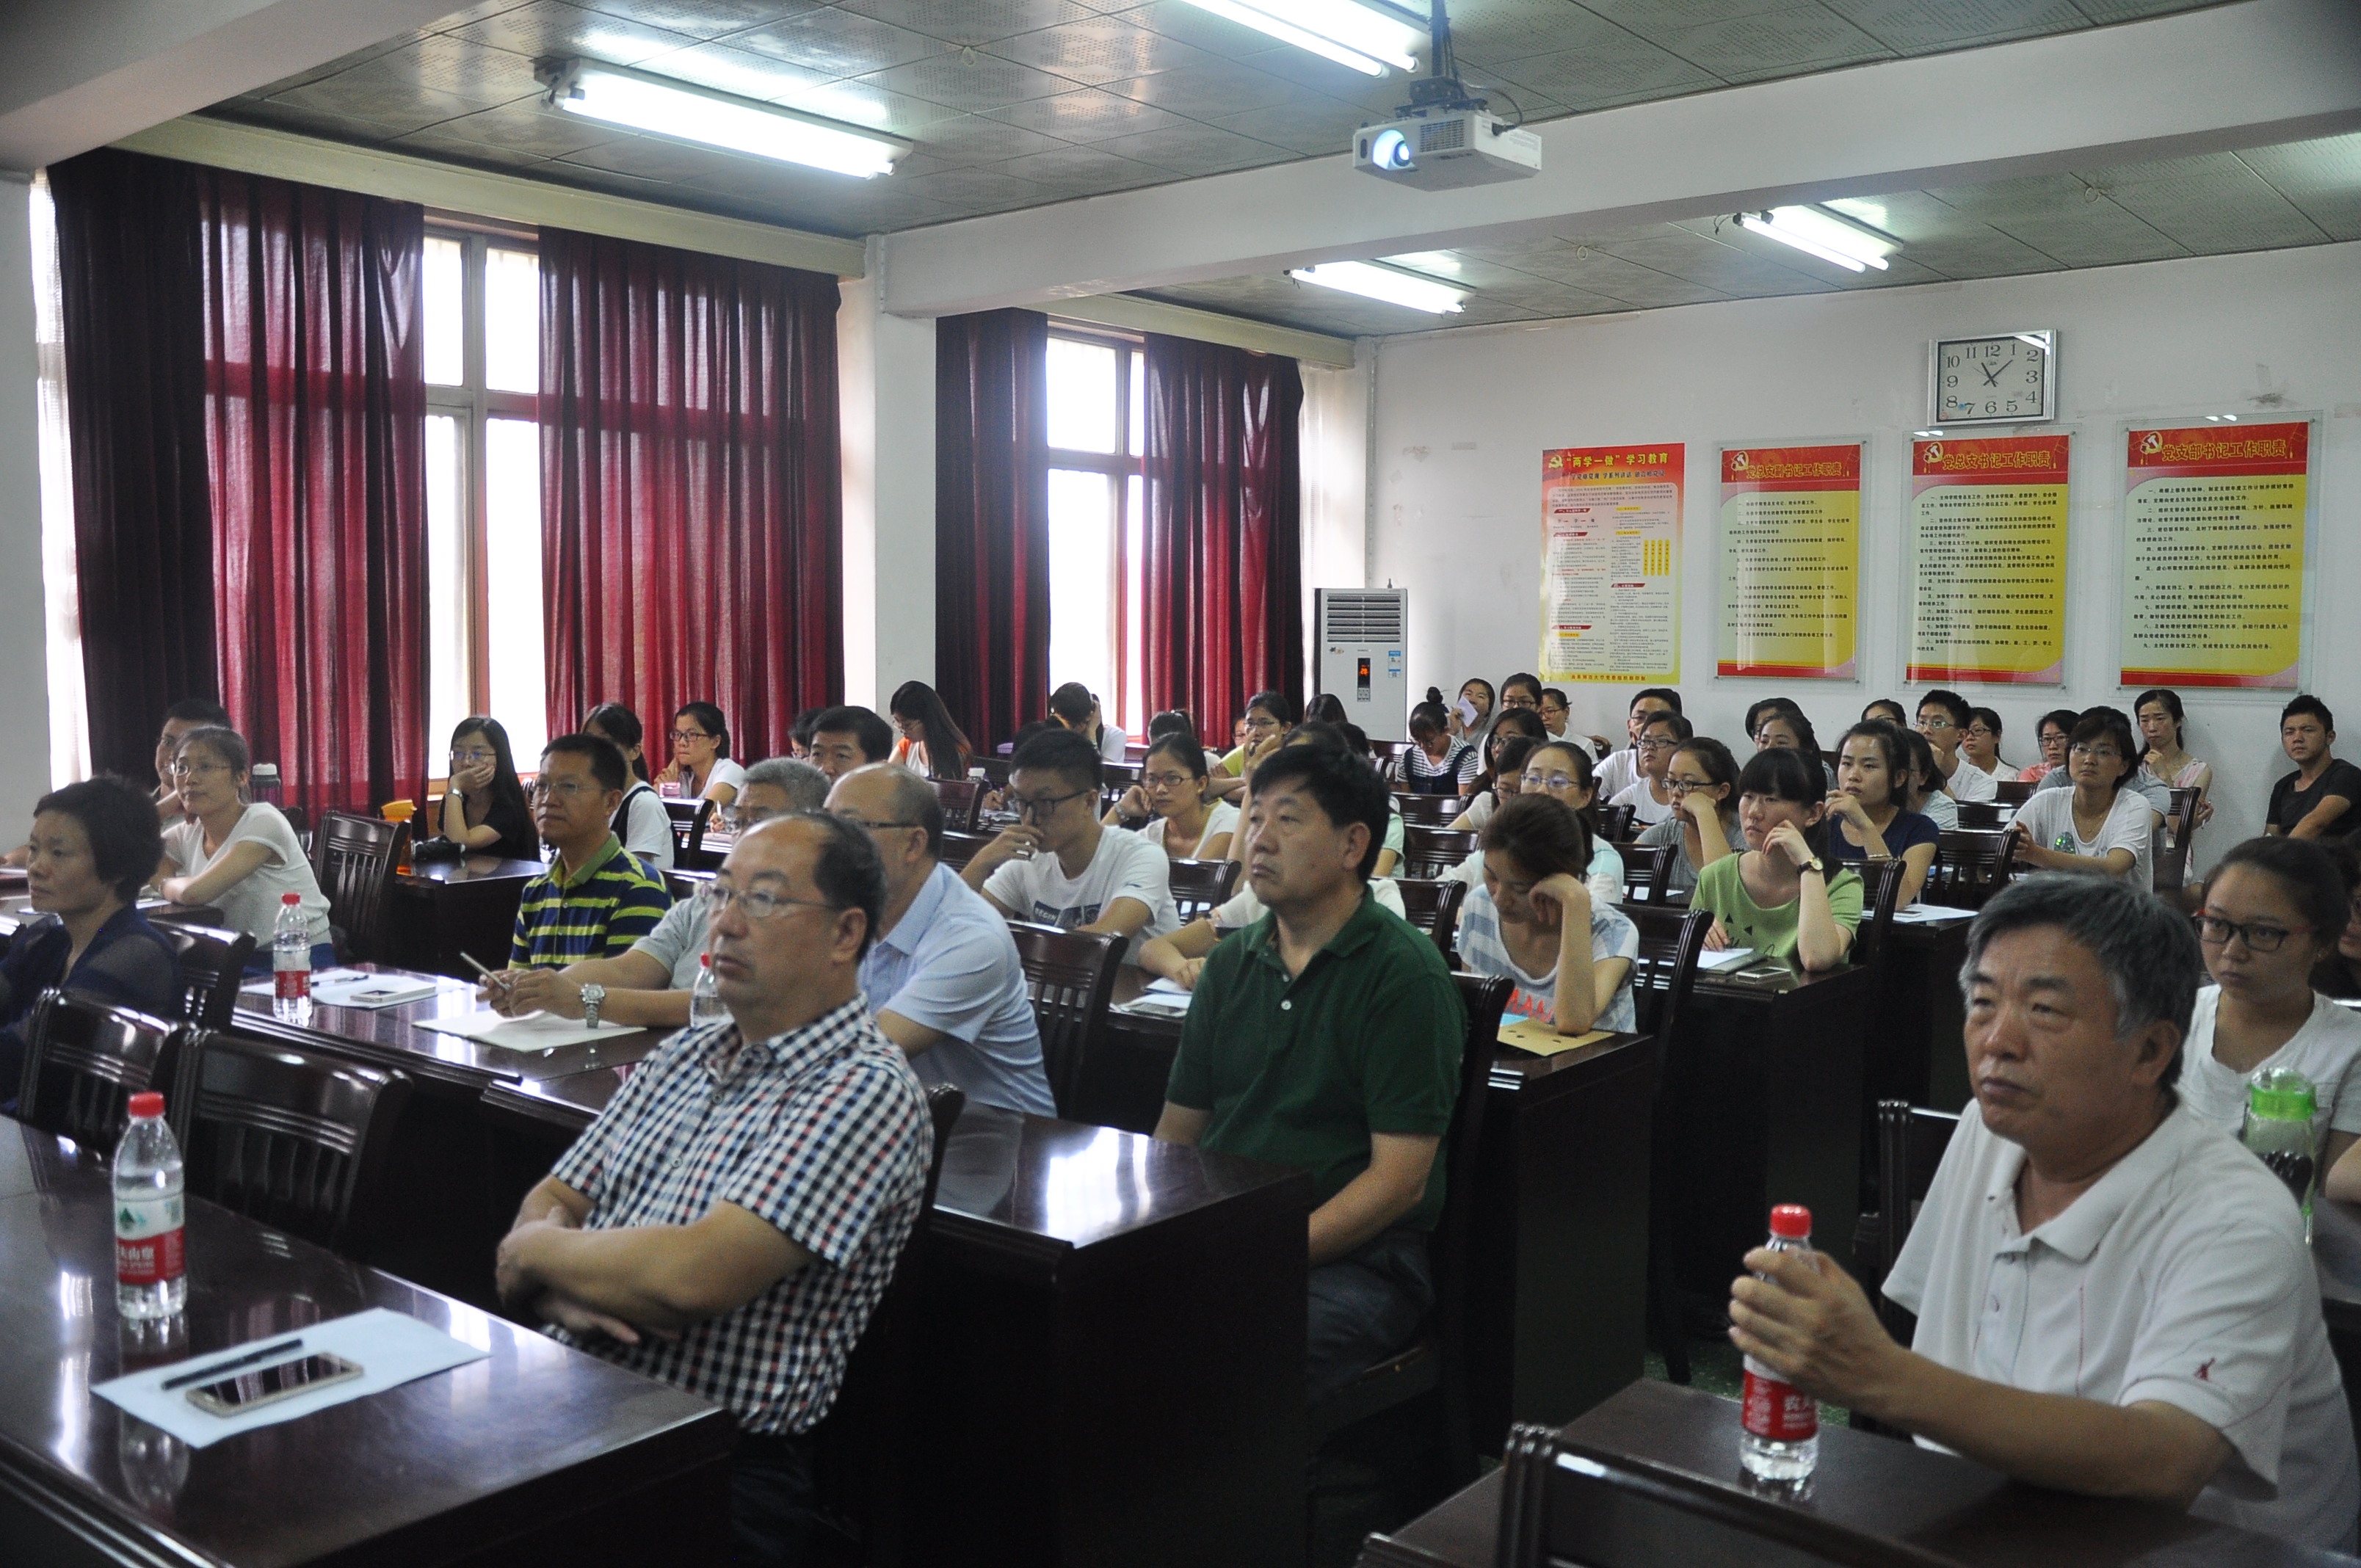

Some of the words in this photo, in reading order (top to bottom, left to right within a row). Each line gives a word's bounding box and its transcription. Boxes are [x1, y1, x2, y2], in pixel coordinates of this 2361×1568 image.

[1966, 346, 1976, 359] 11
[1984, 344, 2001, 357] 12
[2010, 344, 2016, 356] 1
[2026, 349, 2039, 362] 2
[1947, 355, 1960, 368] 10
[1947, 375, 1958, 388] 9
[2025, 371, 2038, 384] 3
[1946, 396, 1958, 408] 8
[2025, 391, 2037, 403] 4
[1965, 402, 1976, 415] 7
[1985, 402, 1997, 414] 6
[2006, 400, 2017, 413] 5
[2162, 439, 2287, 461] 党支部书记工作职责
[1943, 451, 2050, 471] 党总支书记工作职责
